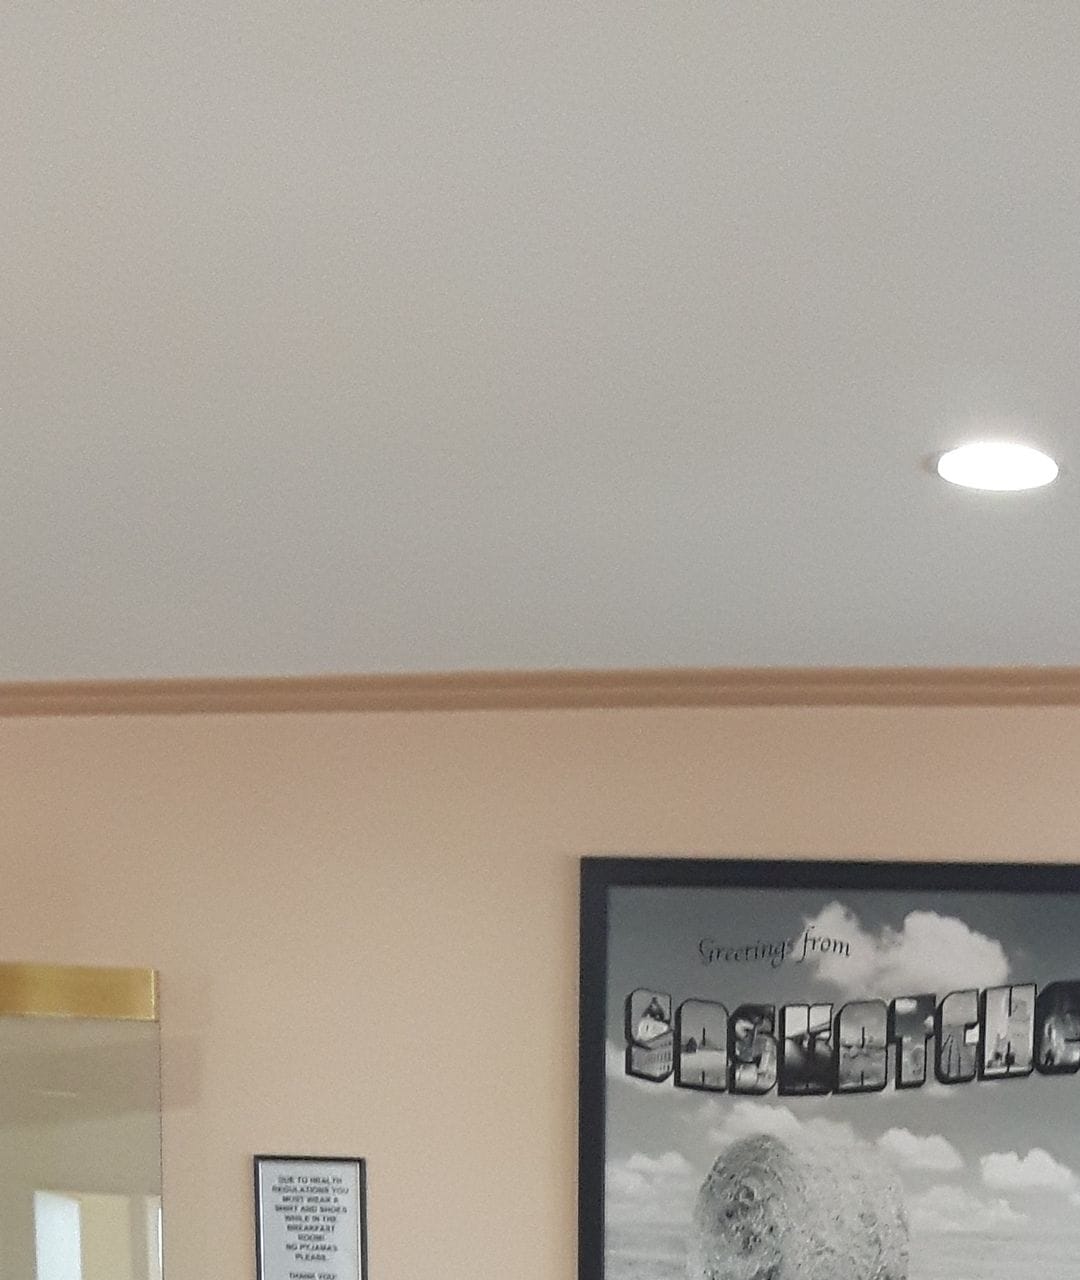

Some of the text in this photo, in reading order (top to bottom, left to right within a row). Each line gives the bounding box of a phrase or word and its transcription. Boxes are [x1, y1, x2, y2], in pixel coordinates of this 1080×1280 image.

[699, 925, 851, 969] Greetings from
[297, 1176, 308, 1184] TO
[310, 1176, 342, 1184] HEALTH
[332, 1186, 349, 1194] YOU
[300, 1205, 318, 1213] AND
[319, 1205, 348, 1213] SHOES
[322, 1215, 337, 1223] THE
[286, 1243, 338, 1252] NO PYJAMAS
